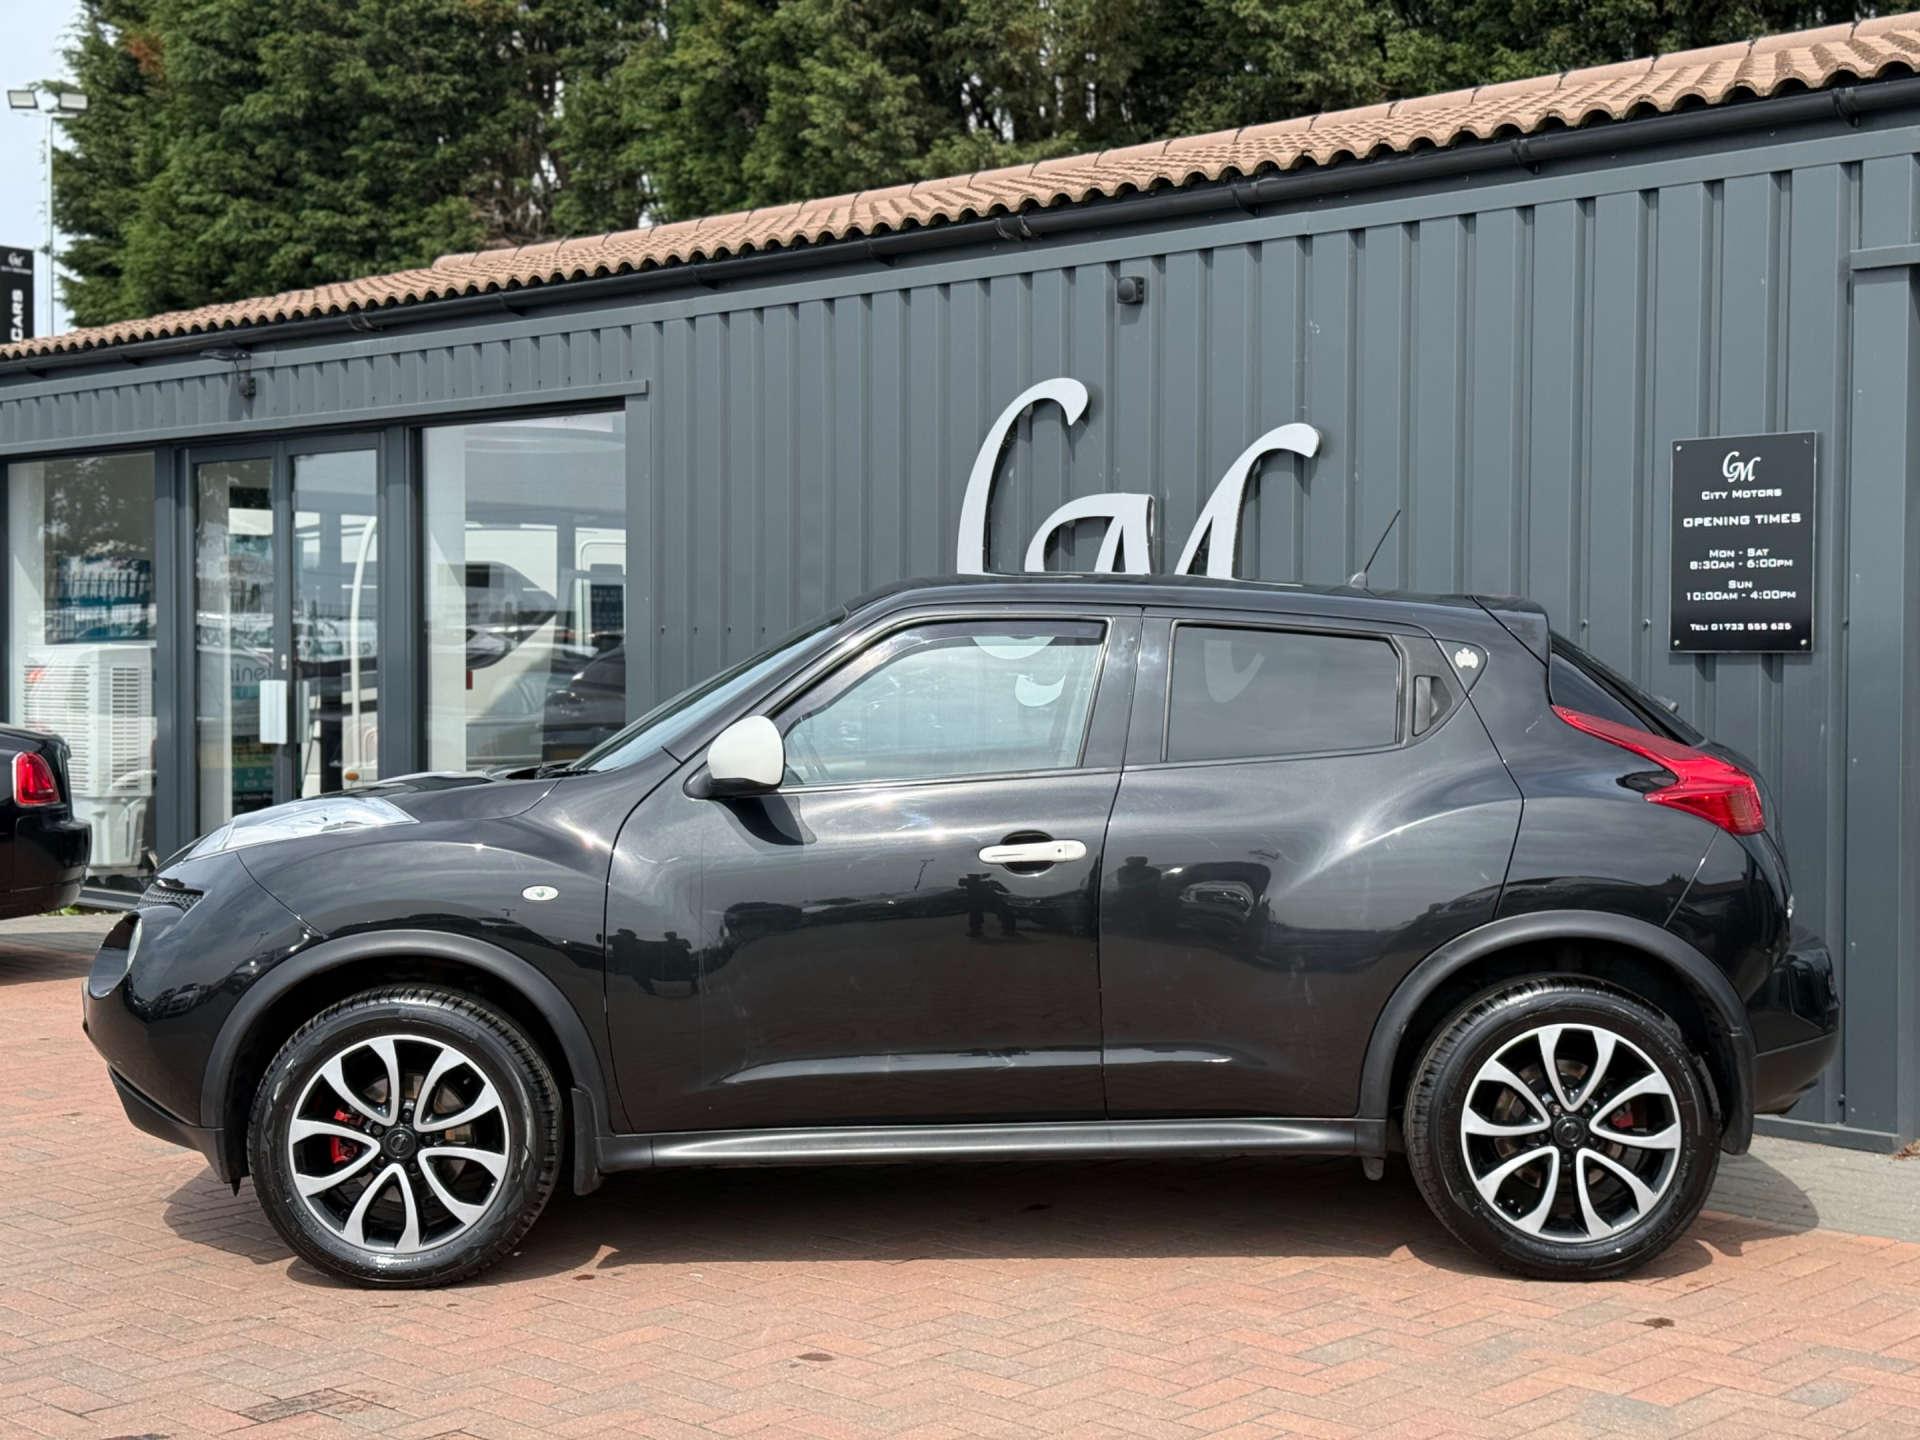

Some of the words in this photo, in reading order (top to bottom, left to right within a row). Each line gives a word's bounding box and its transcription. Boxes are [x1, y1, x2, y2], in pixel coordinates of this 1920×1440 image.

[10, 288, 24, 342] CARS
[1701, 490, 1729, 501] CITY
[1731, 487, 1782, 499] MOTORS
[1683, 514, 1751, 528] OPENING
[1754, 512, 1802, 525] TIMES
[1709, 549, 1736, 559] MON
[1747, 547, 1770, 558] SAT
[1690, 560, 1736, 571] 8:30AM
[1746, 558, 1794, 569] 6:00PM
[1727, 579, 1754, 590] SUN
[1749, 589, 1797, 600] 4:00PM
